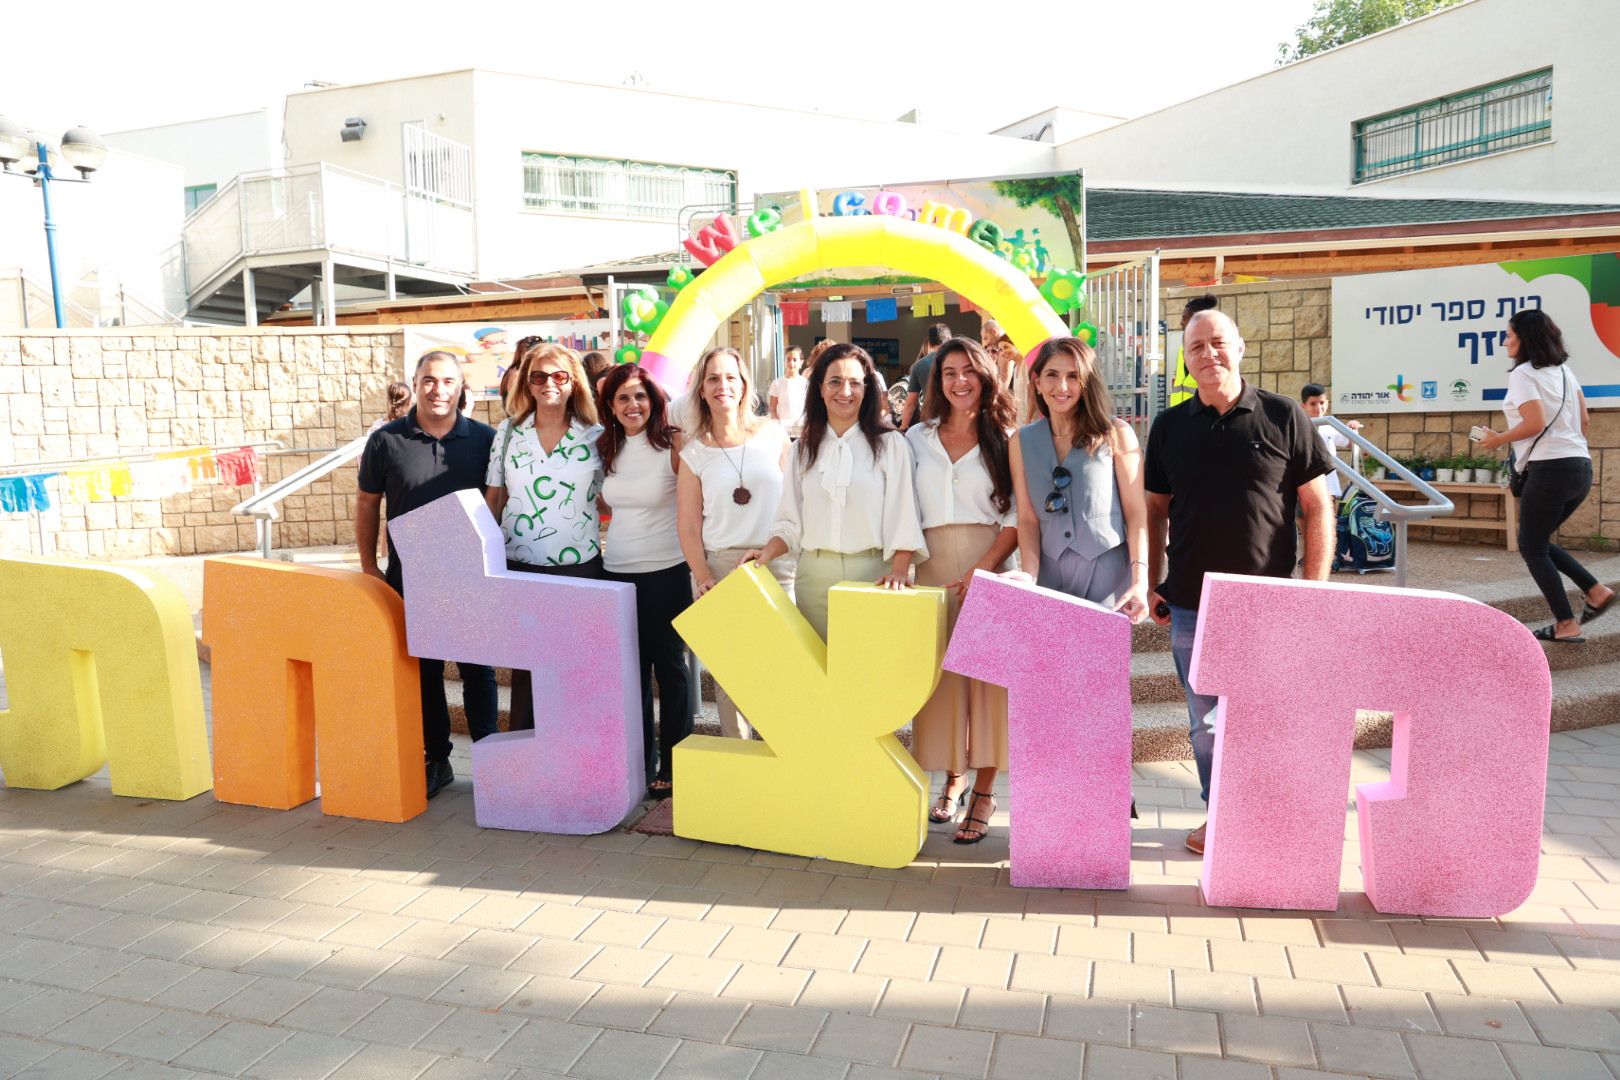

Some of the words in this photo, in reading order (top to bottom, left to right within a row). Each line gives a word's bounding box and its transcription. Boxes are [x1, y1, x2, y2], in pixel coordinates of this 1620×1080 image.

[1365, 303, 1422, 326] יסודי
[1431, 299, 1486, 321] ספר
[1458, 330, 1507, 364] יזף
[1351, 392, 1374, 400] יהודה
[1375, 391, 1390, 399] אור
